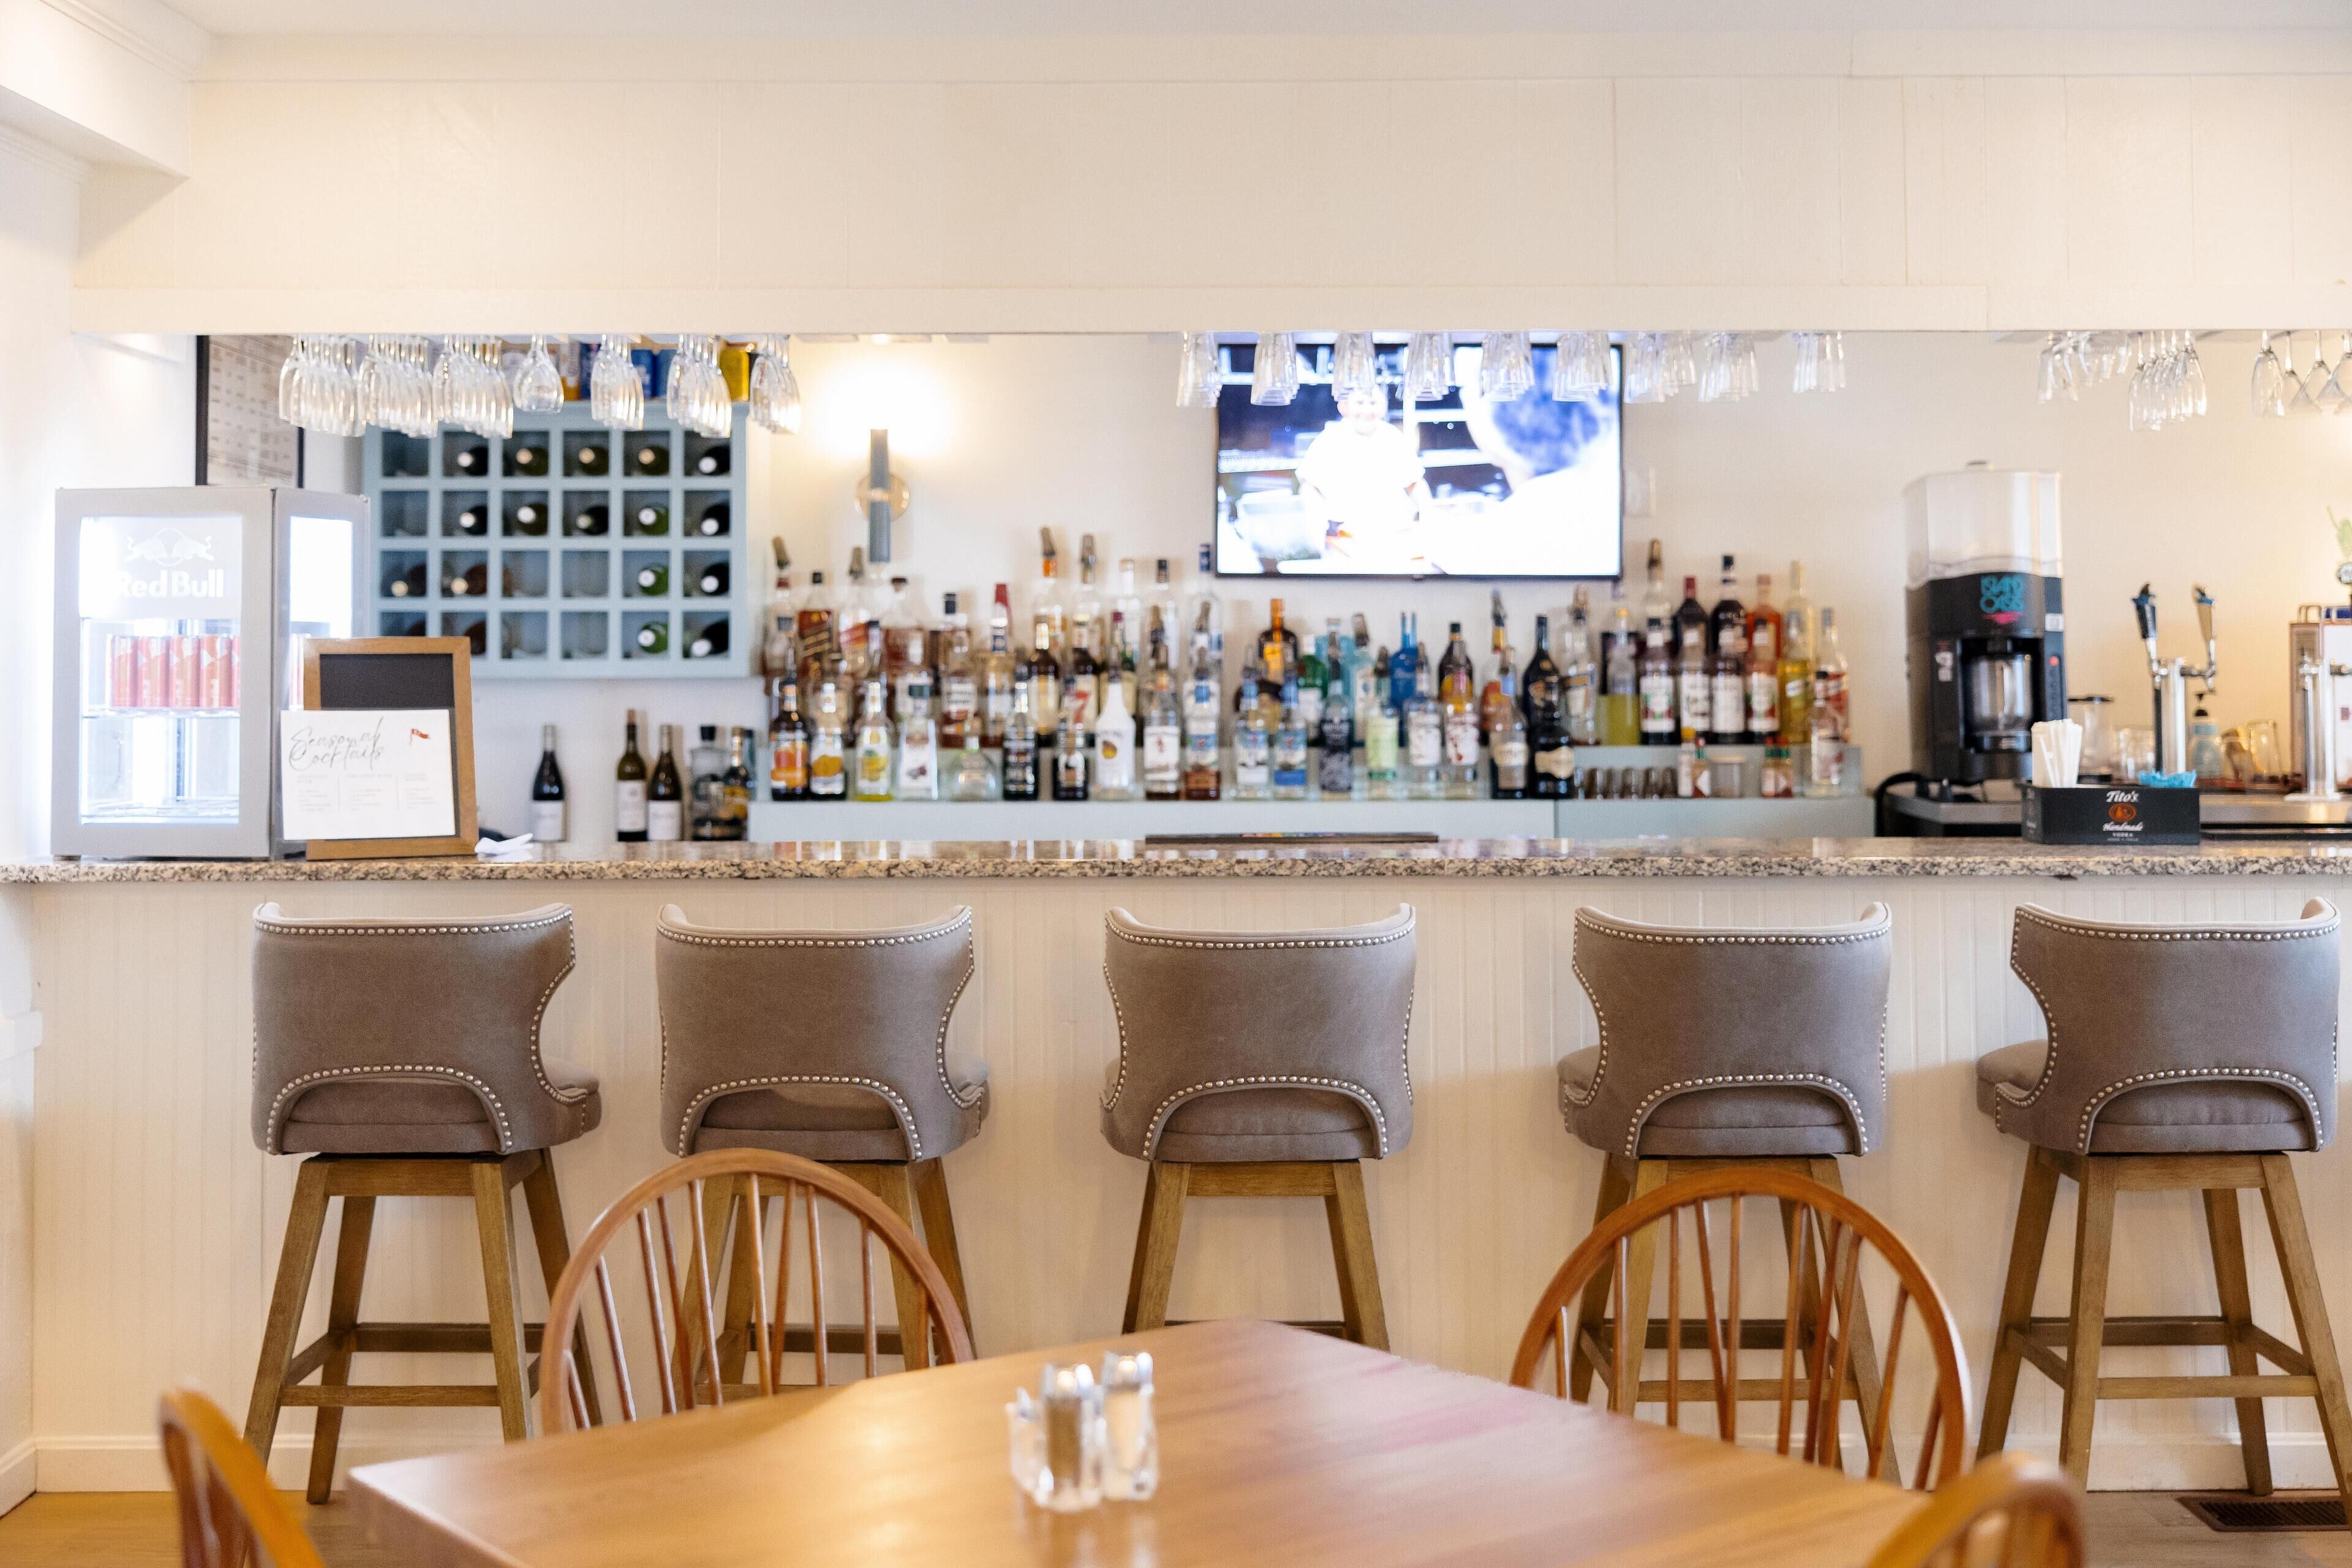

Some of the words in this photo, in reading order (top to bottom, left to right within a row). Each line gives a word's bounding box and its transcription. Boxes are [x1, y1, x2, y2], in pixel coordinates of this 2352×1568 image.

[117, 569, 167, 598] Red
[172, 568, 224, 598] Bull
[291, 716, 383, 756] Seasonal
[289, 739, 383, 771] Cocktails
[2106, 790, 2139, 802] Tito's
